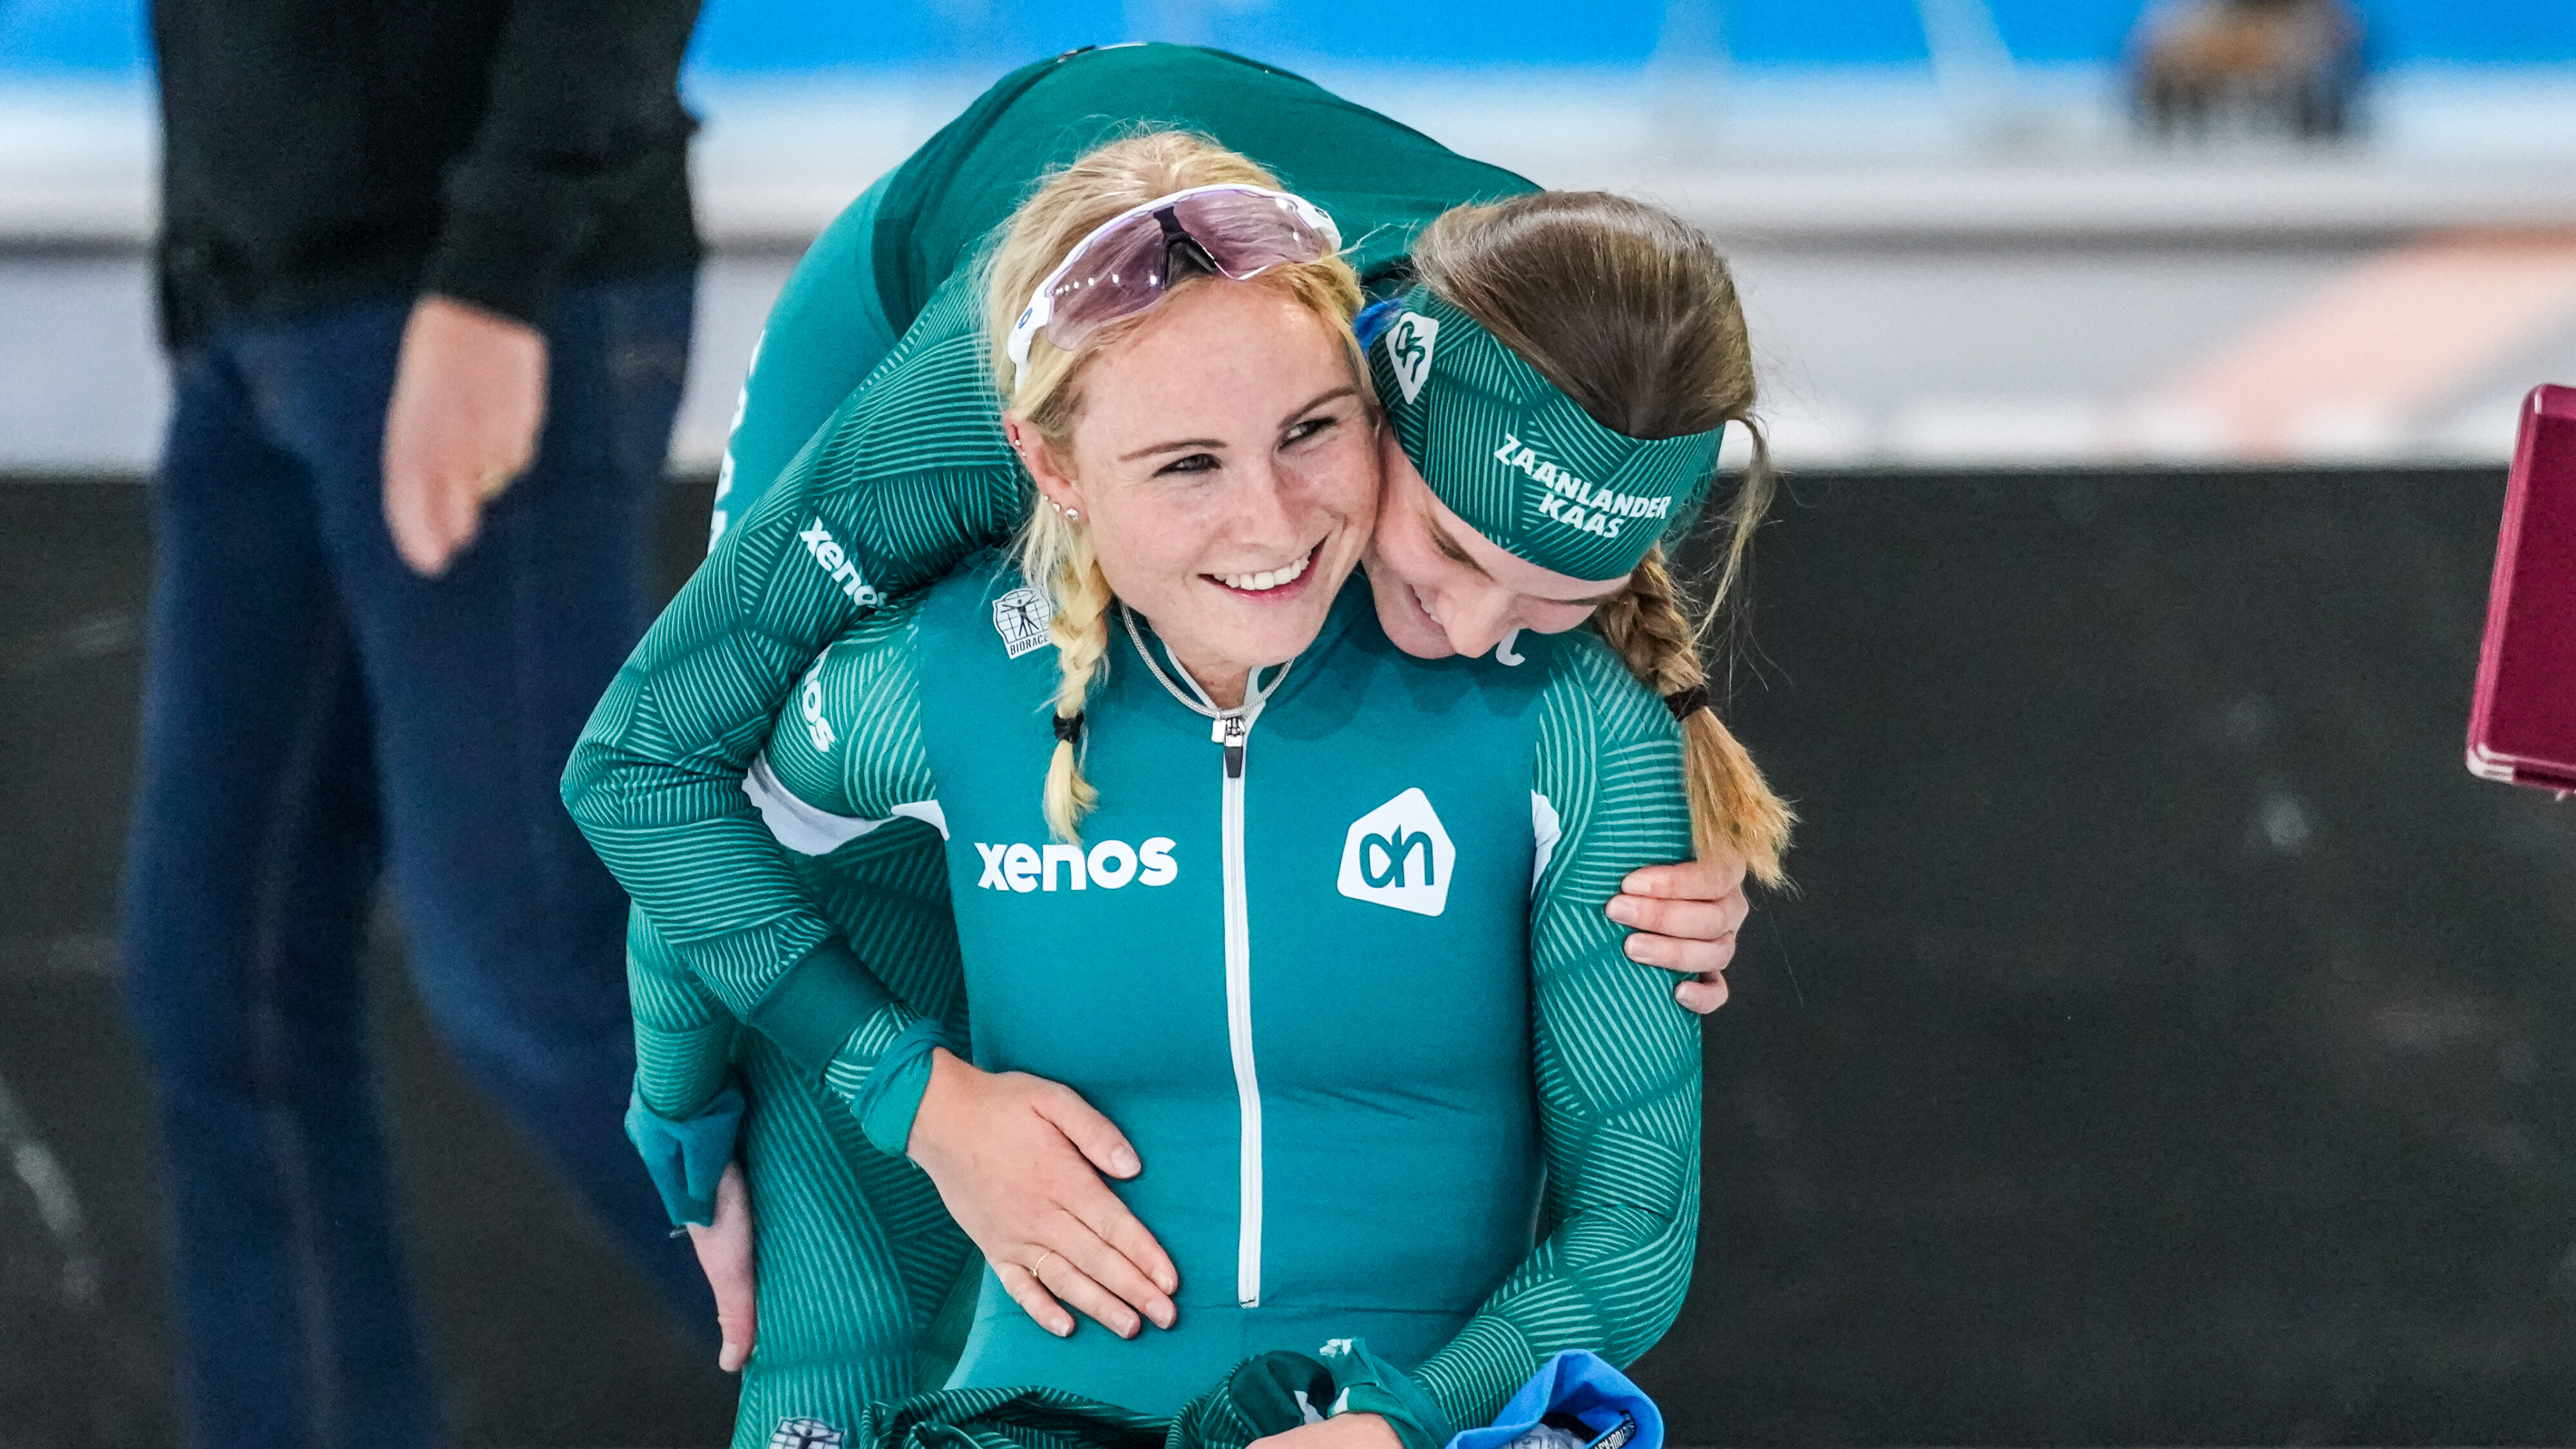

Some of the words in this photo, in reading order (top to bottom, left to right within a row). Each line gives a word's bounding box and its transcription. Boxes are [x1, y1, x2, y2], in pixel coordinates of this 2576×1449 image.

[1493, 433, 1672, 520] ZAANLANDER
[1539, 492, 1624, 538] KAAS
[974, 837, 1178, 893] xenos
